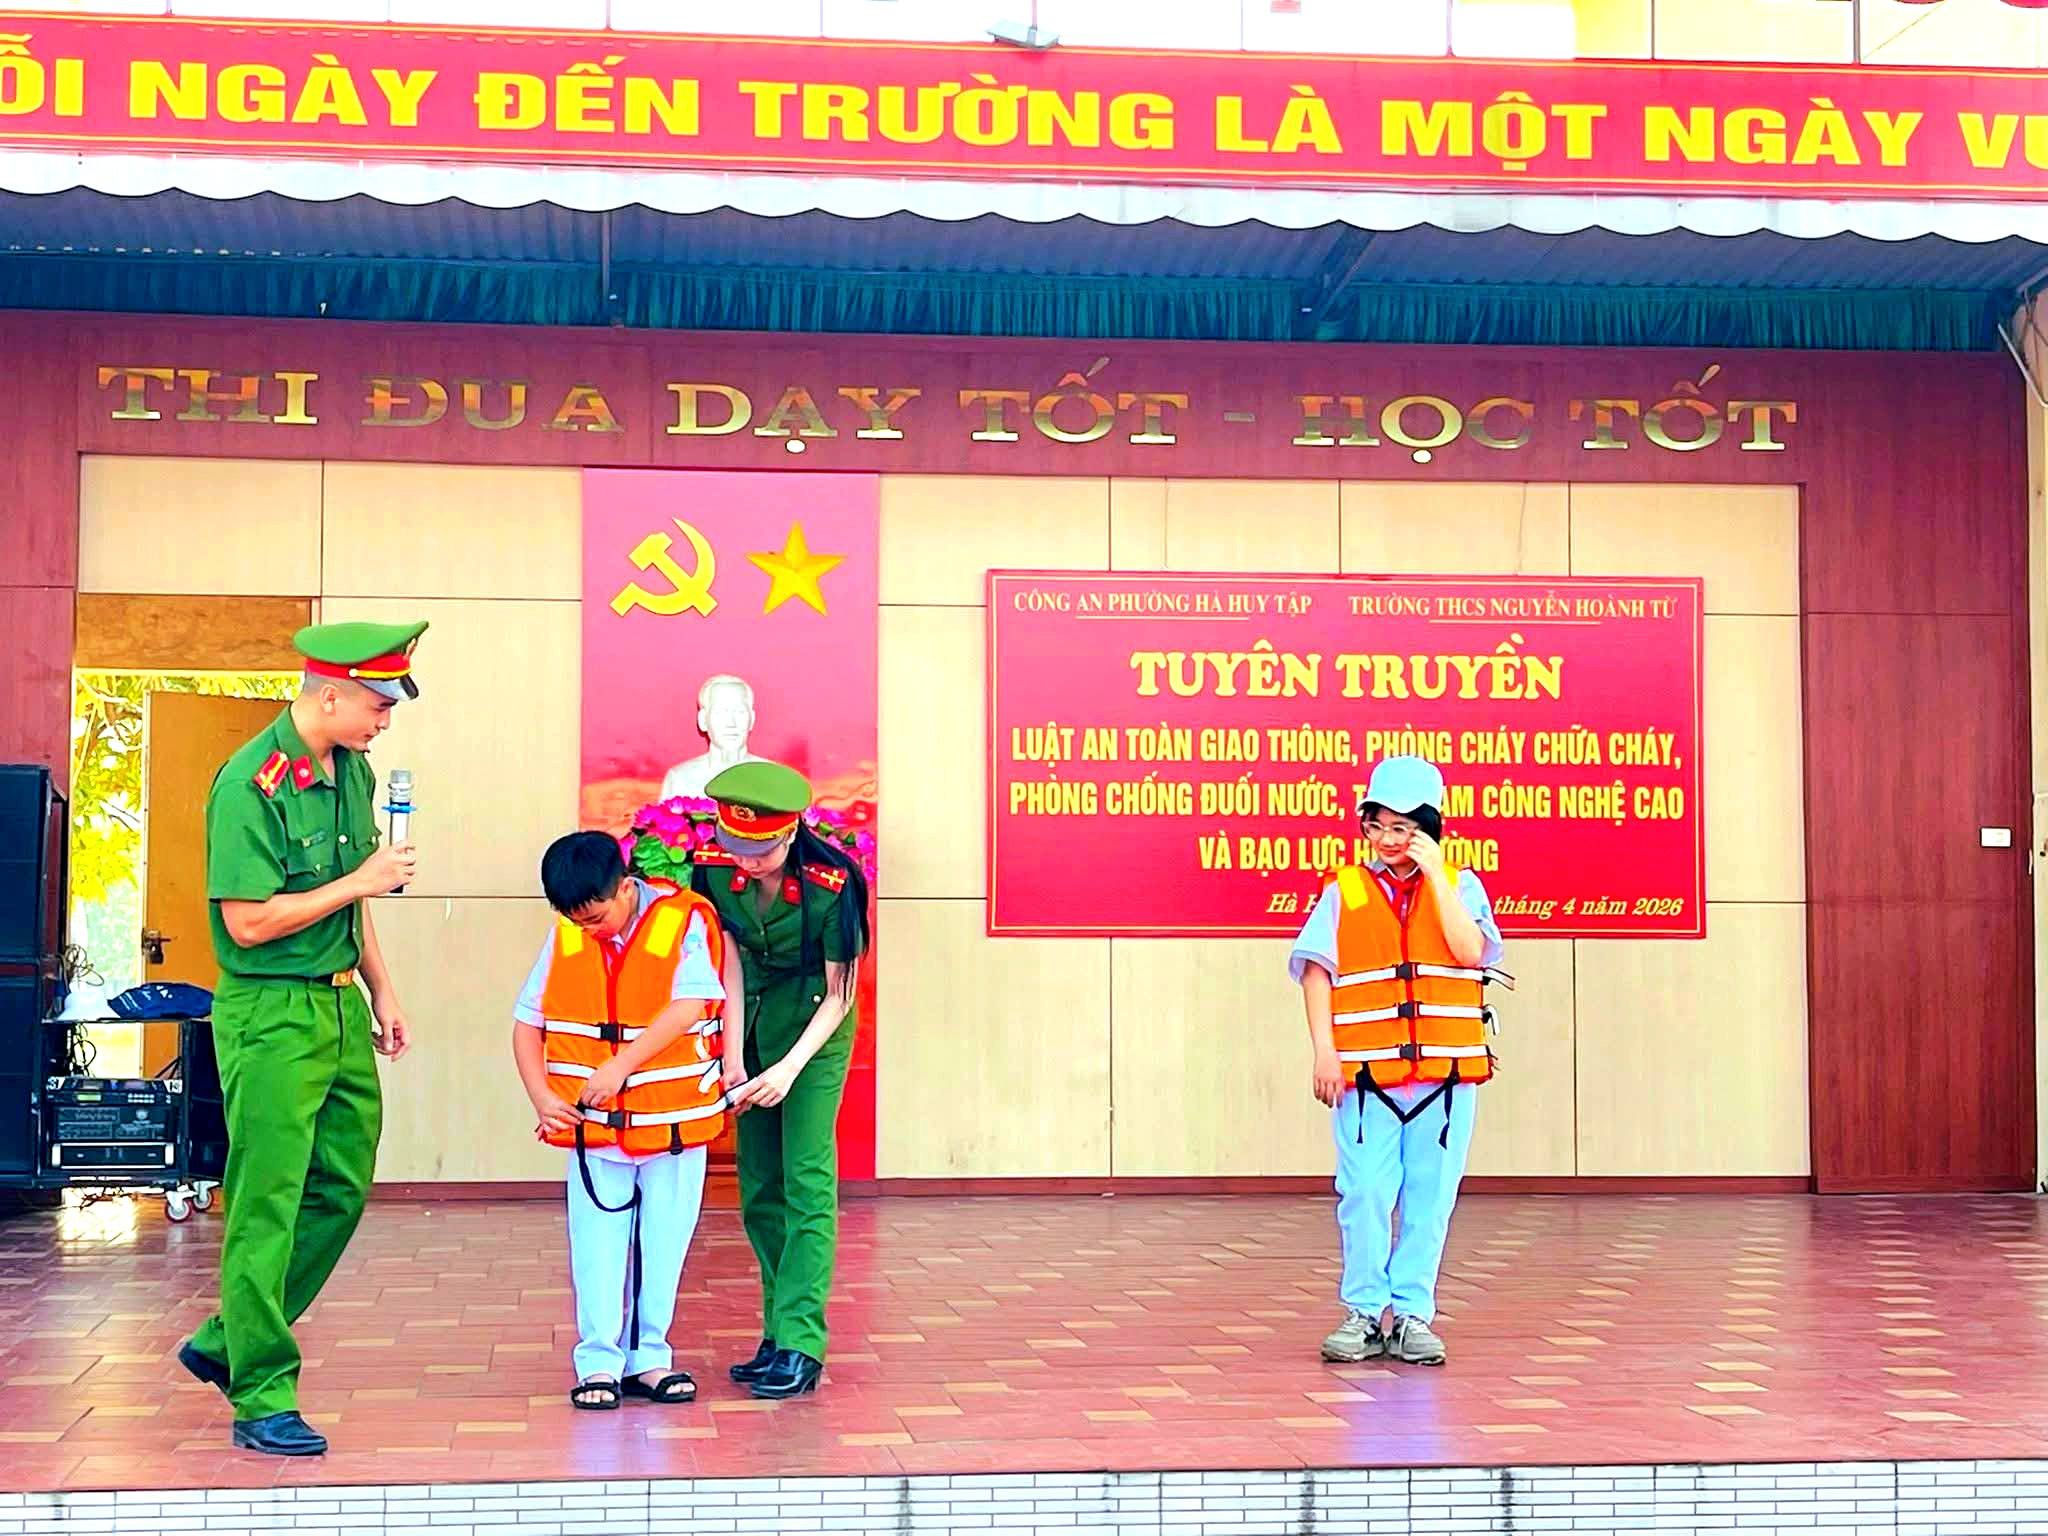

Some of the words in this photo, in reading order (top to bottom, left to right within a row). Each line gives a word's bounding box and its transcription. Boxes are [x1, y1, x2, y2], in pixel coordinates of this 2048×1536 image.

[130, 54, 438, 126] NGÀY
[474, 56, 699, 136] ĐẾN
[739, 73, 1174, 149] TRƯỜNG
[1216, 85, 1342, 153] LÀ
[1381, 91, 1607, 172] MỘT
[1645, 98, 1924, 166] NGÀY
[98, 367, 318, 425] THI
[359, 376, 625, 433] ĐUA
[665, 383, 921, 455] DẠY
[959, 357, 1189, 445] TỐT
[1292, 395, 1534, 464] HỌC
[1569, 363, 1798, 451] TỐT
[1014, 588, 1070, 611] CÔNG
[1077, 593, 1103, 611] AN
[1108, 590, 1190, 613] PHƯỜNG
[1195, 592, 1223, 612] HÀ
[1228, 594, 1270, 613] HUY
[1273, 591, 1312, 617] TẬP
[1349, 592, 1430, 615] TRƯỜNG
[1435, 597, 1486, 616] THCS
[1490, 590, 1570, 616] NGUYỄN
[1576, 594, 1645, 617] HOÀNH
[1649, 595, 1678, 618] TỪ
[1130, 639, 1321, 697] TUYÊN
[1335, 633, 1563, 699] TRUYỀN
[1012, 721, 1074, 767] LUẬT
[1082, 728, 1118, 760] AN
[1126, 721, 1192, 761] TOÀN
[1200, 729, 1259, 761] GIAO
[1267, 723, 1358, 766] THÔNG,
[1366, 723, 1452, 763] PHÒNG
[1460, 725, 1526, 764] CHÁY
[1534, 725, 1601, 765] CHỮA
[1609, 726, 1682, 769] CHÁY,
[1010, 773, 1098, 815] PHÒNG
[1106, 771, 1193, 816] CHỐNG
[1200, 771, 1260, 816] ĐUỐI
[1268, 774, 1344, 820] NƯỚC,
[1483, 780, 1551, 818] CÔNG
[1559, 780, 1626, 825] NGHỆ
[1634, 787, 1684, 819] CAO
[1199, 830, 1232, 869] VÀ
[1240, 837, 1291, 877] BẠO
[1299, 834, 1346, 877] LỰC
[1266, 892, 1297, 913] Hà
[1494, 895, 1558, 920] tháng
[1562, 897, 1576, 915] 4
[1580, 896, 1627, 915] năm
[1632, 897, 1685, 916] 2026
